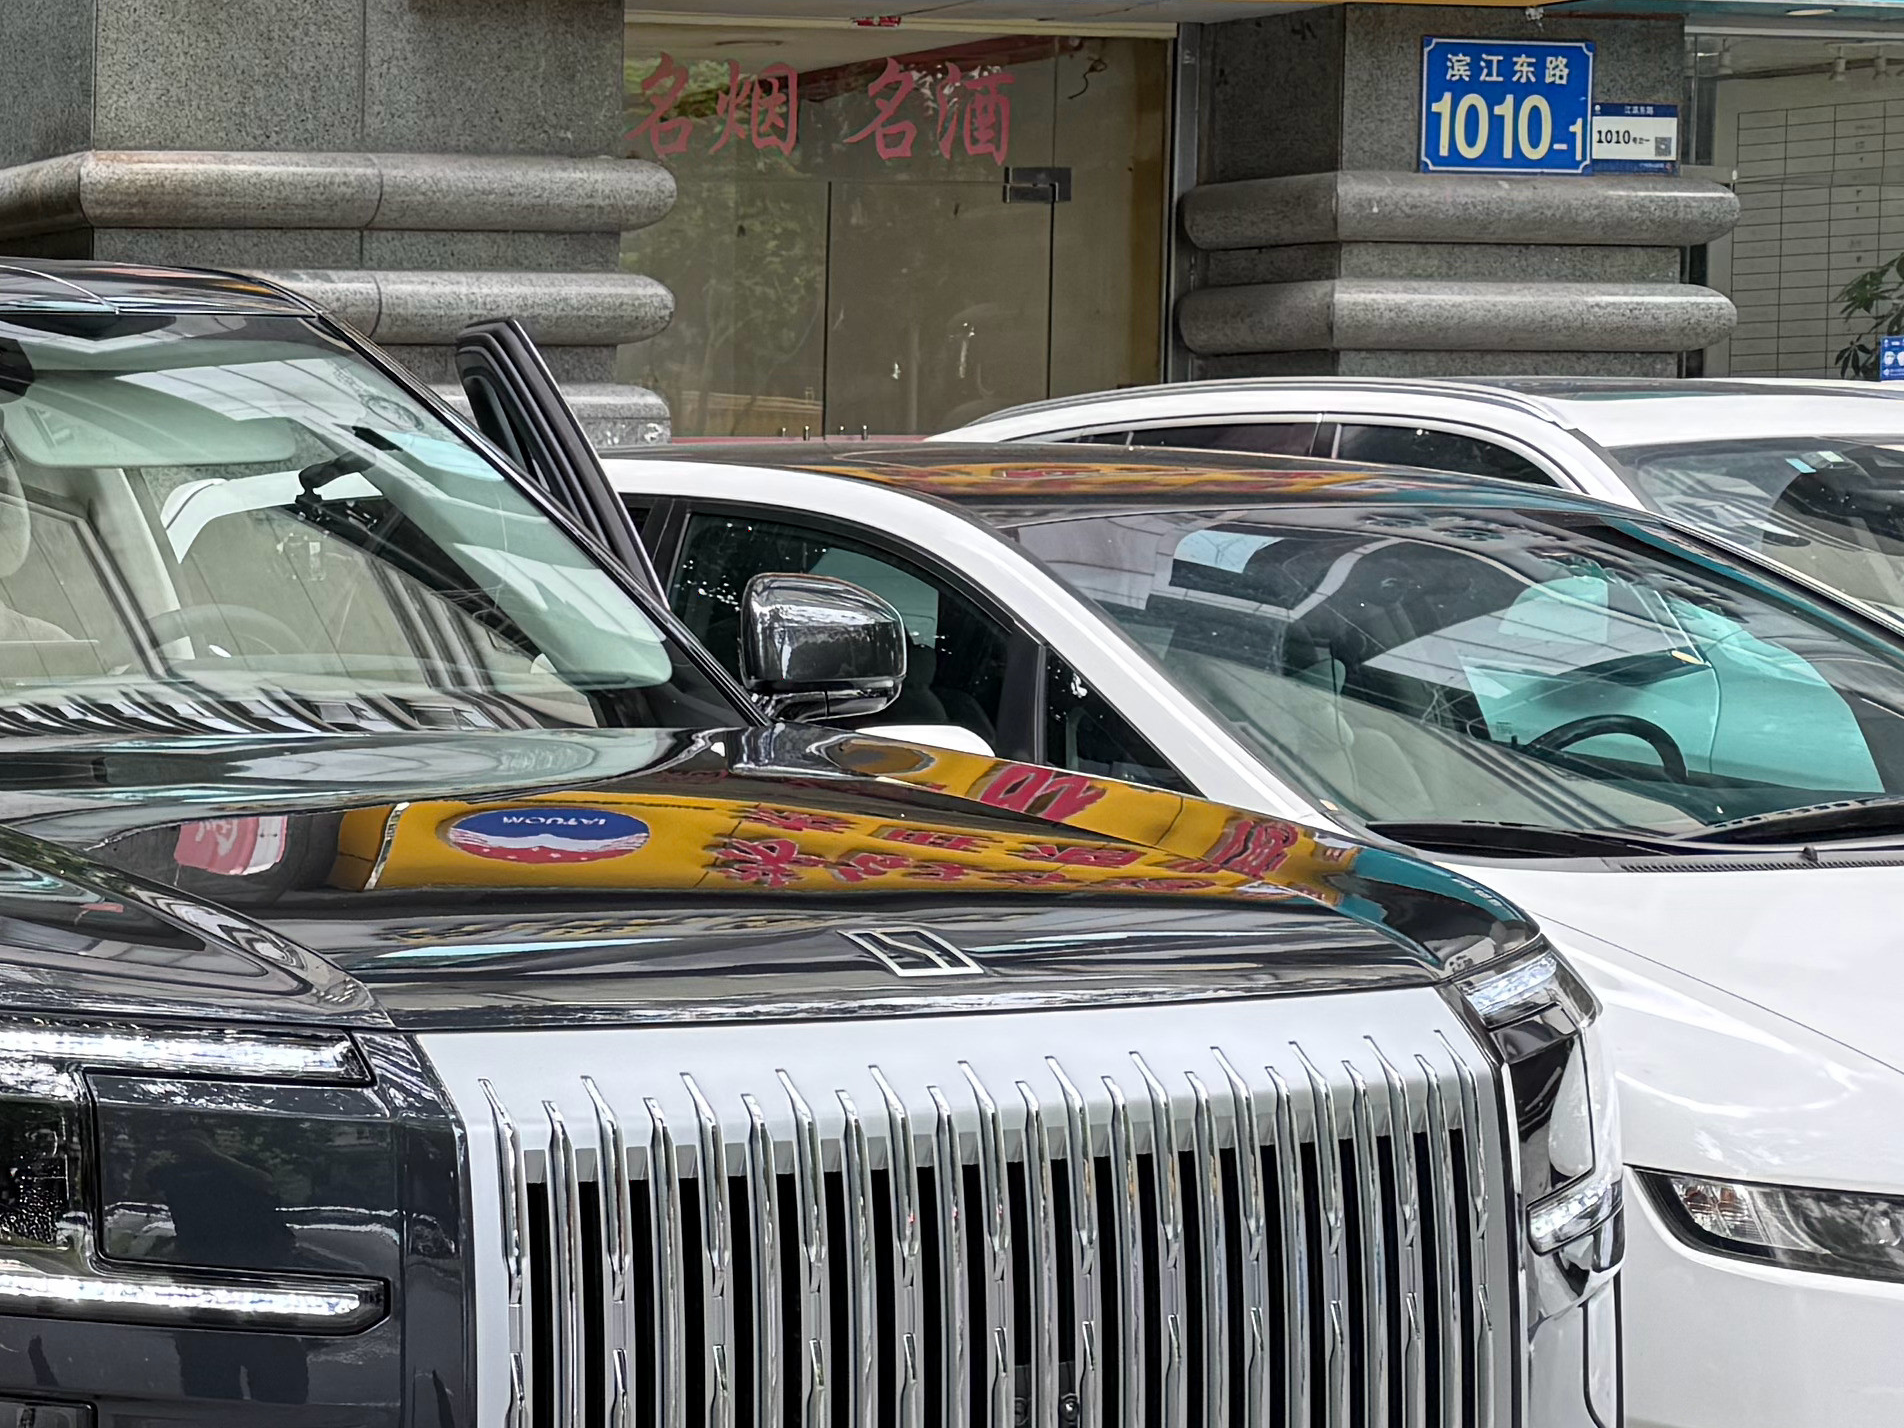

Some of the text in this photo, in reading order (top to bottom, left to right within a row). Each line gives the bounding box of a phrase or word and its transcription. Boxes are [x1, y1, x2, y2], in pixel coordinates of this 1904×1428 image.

[1445, 53, 1570, 85] 滨江东路
[625, 51, 1015, 166] 名烟 名酒
[1431, 91, 1583, 161] 1010-1
